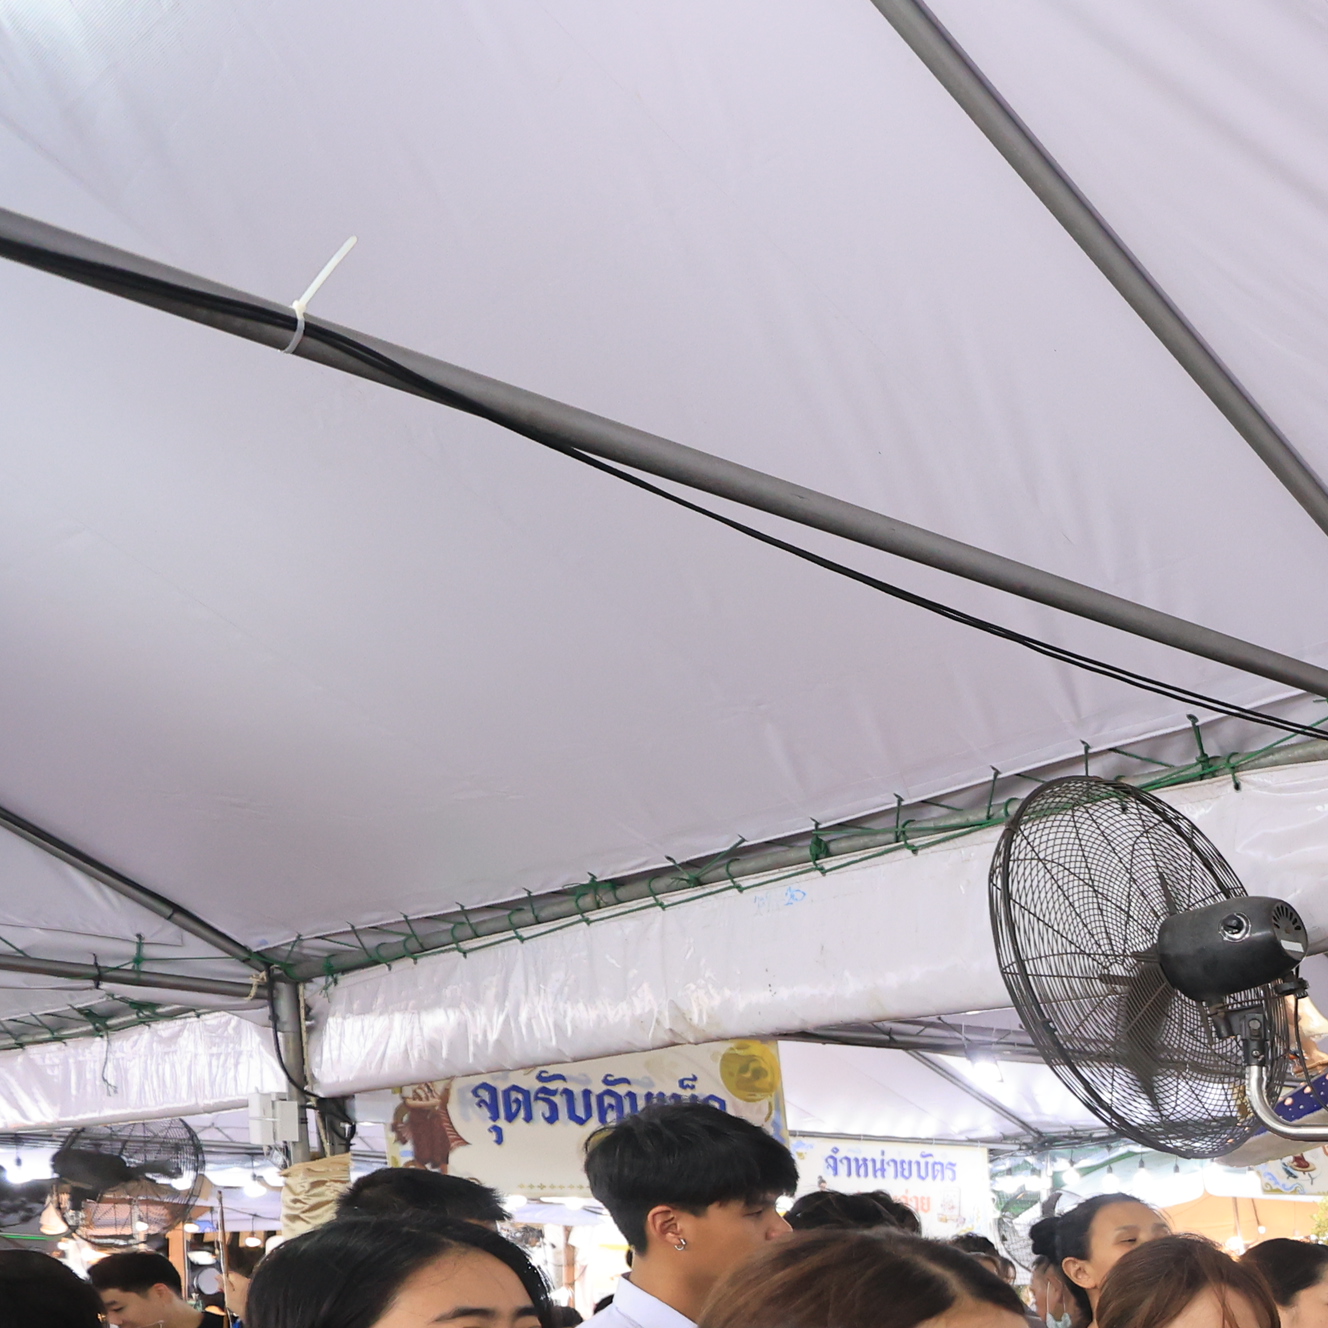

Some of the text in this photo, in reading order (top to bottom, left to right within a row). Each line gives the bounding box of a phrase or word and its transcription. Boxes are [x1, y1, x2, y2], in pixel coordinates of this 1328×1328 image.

[824, 1146, 958, 1183] จำหน่ายบัตร
